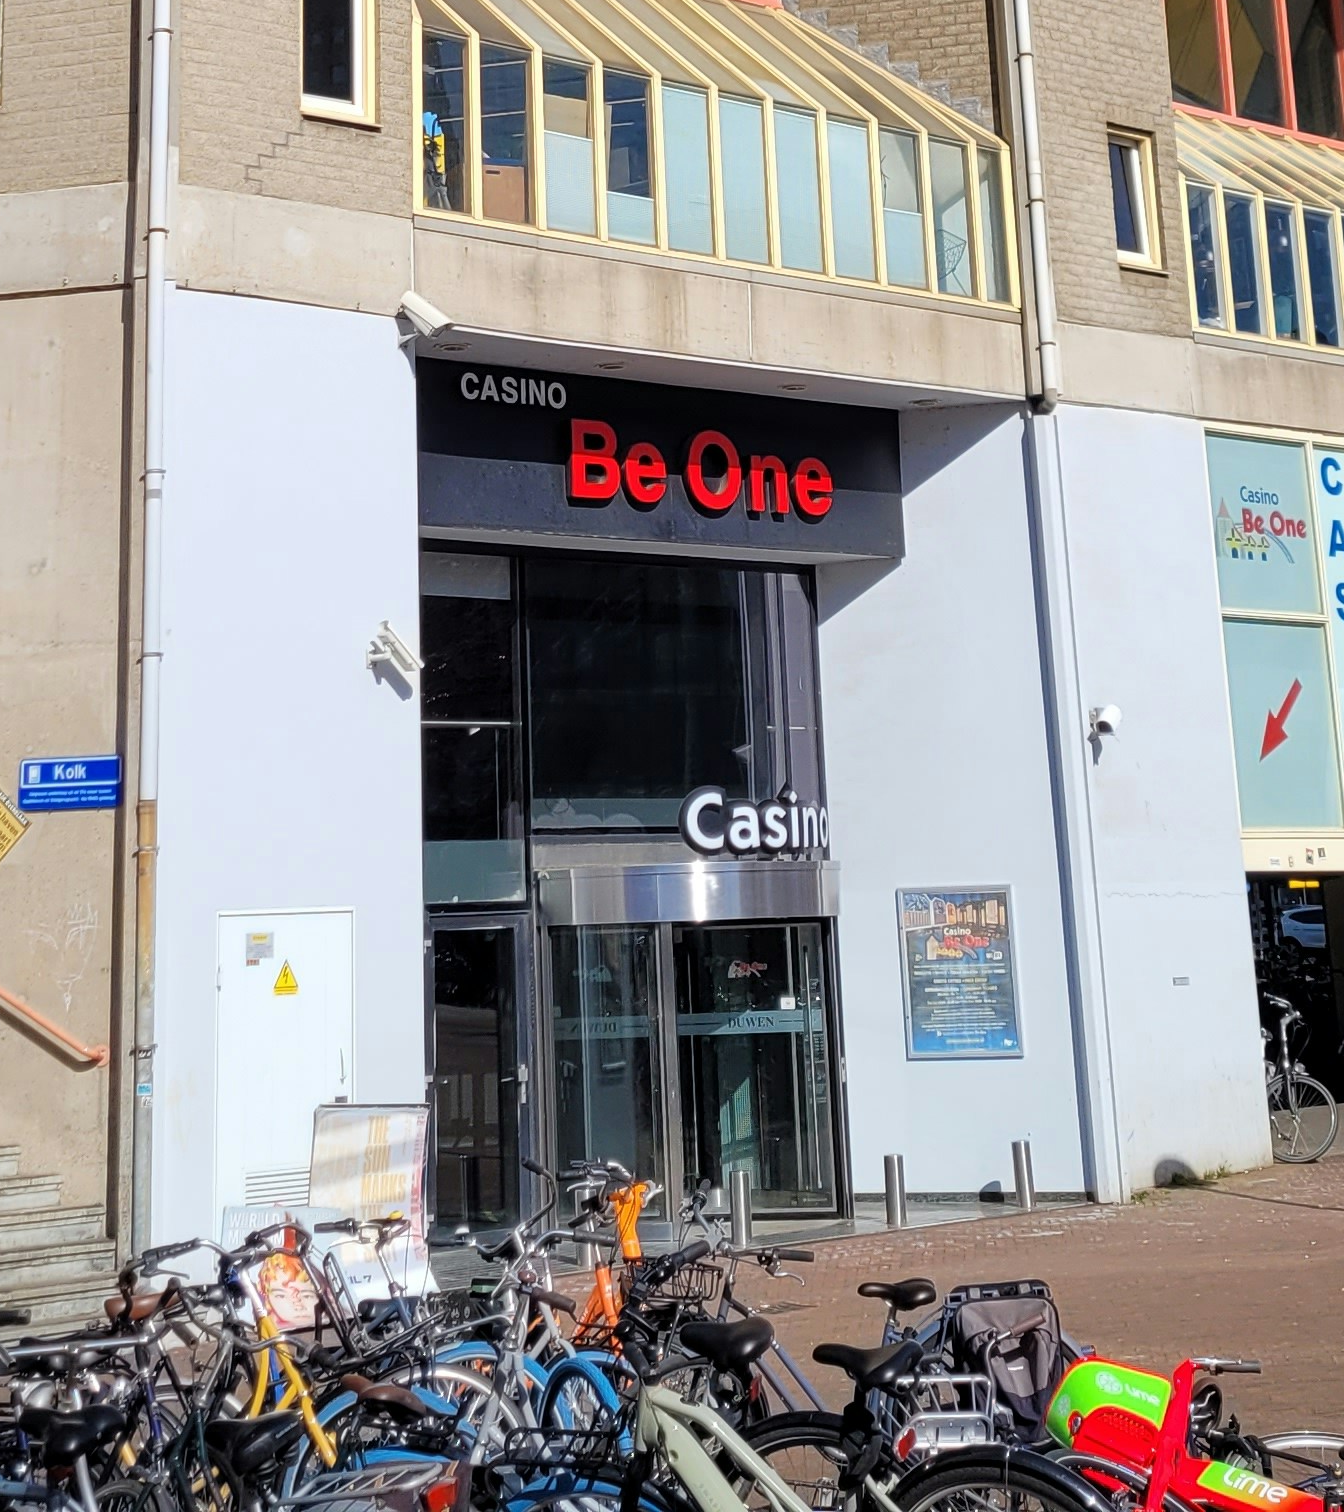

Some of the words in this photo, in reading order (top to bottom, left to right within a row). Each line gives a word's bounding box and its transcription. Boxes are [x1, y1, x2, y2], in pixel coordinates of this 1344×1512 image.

[460, 372, 566, 409] CASINO
[570, 418, 667, 503] Be
[687, 429, 833, 516] One
[1239, 485, 1279, 505] Casino
[1242, 507, 1265, 535] Be
[1269, 510, 1307, 539] One
[54, 764, 87, 780] Kolk
[686, 791, 829, 850] Casino
[943, 927, 972, 936] Casino
[728, 1016, 775, 1028] DUWEN
[1125, 1383, 1161, 1407] Lime
[1223, 1466, 1288, 1504] Lime
